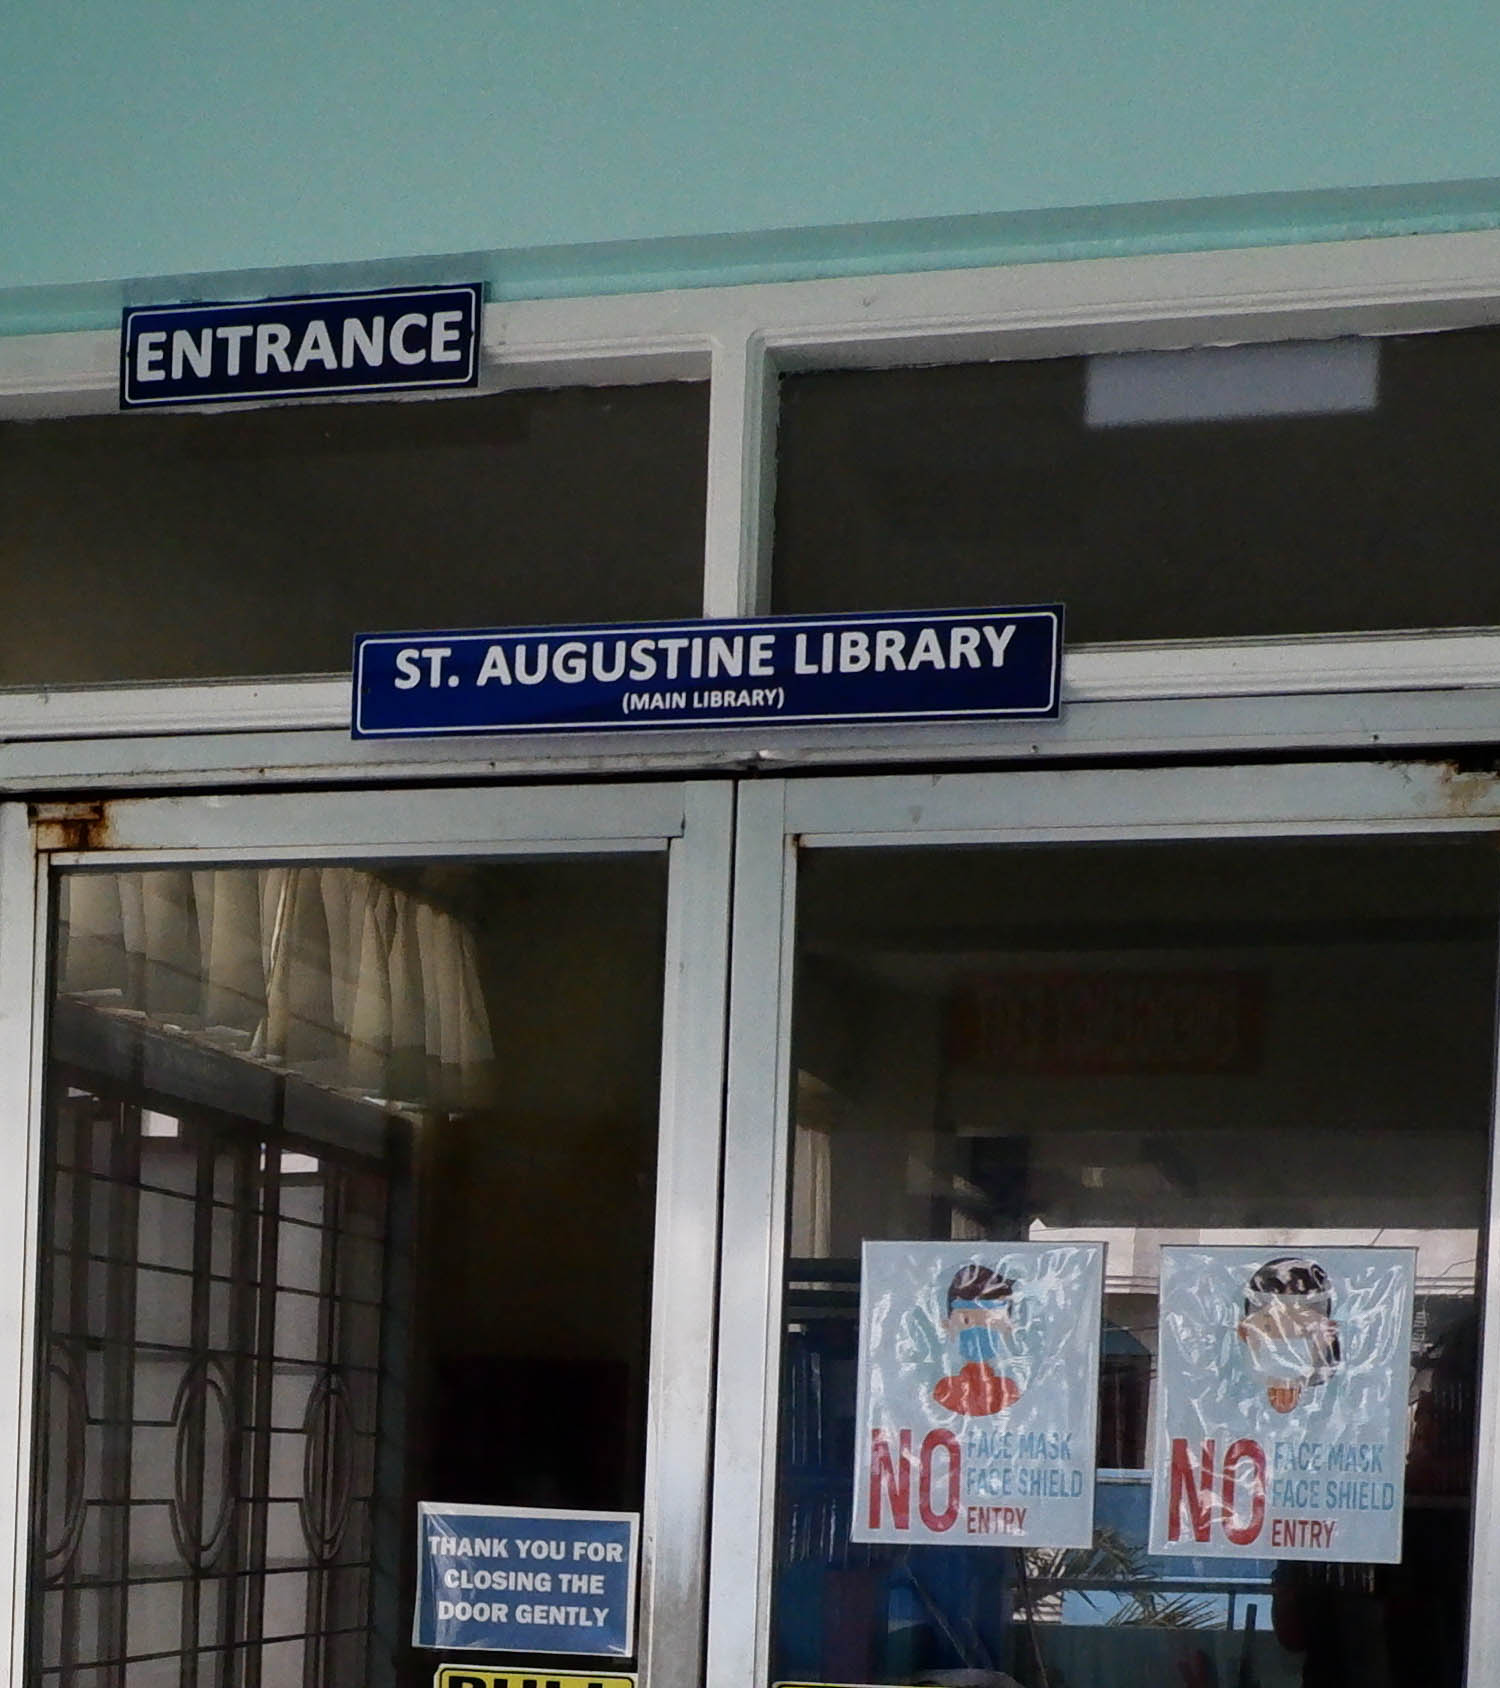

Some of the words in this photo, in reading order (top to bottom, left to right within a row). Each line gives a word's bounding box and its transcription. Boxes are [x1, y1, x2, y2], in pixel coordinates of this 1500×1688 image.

[136, 310, 463, 382] ENTRANCE
[394, 646, 460, 688] ST.
[476, 632, 776, 687] AUGUSTINE
[794, 624, 1016, 675] LIBRARY
[622, 689, 687, 714] (MAIN
[693, 686, 786, 711] LIBRARY)
[967, 1431, 1013, 1460] FACE
[1018, 1431, 1073, 1461] MASK
[1273, 1441, 1323, 1473] FACE
[1328, 1443, 1385, 1474] MASK
[869, 1428, 961, 1532] NO
[1019, 1468, 1083, 1498] SHIELD
[1168, 1438, 1267, 1545] NO
[1272, 1479, 1320, 1509] FACE
[1326, 1480, 1395, 1512] SHIELD
[427, 1535, 508, 1558] THANK
[514, 1539, 566, 1561] YOU
[572, 1541, 624, 1563] FOR
[1271, 1518, 1336, 1549] ENTRY
[444, 1568, 552, 1592] CLOSING
[558, 1573, 605, 1595] THE
[438, 1600, 508, 1624] DOOR
[515, 1604, 610, 1628] GENTLY
